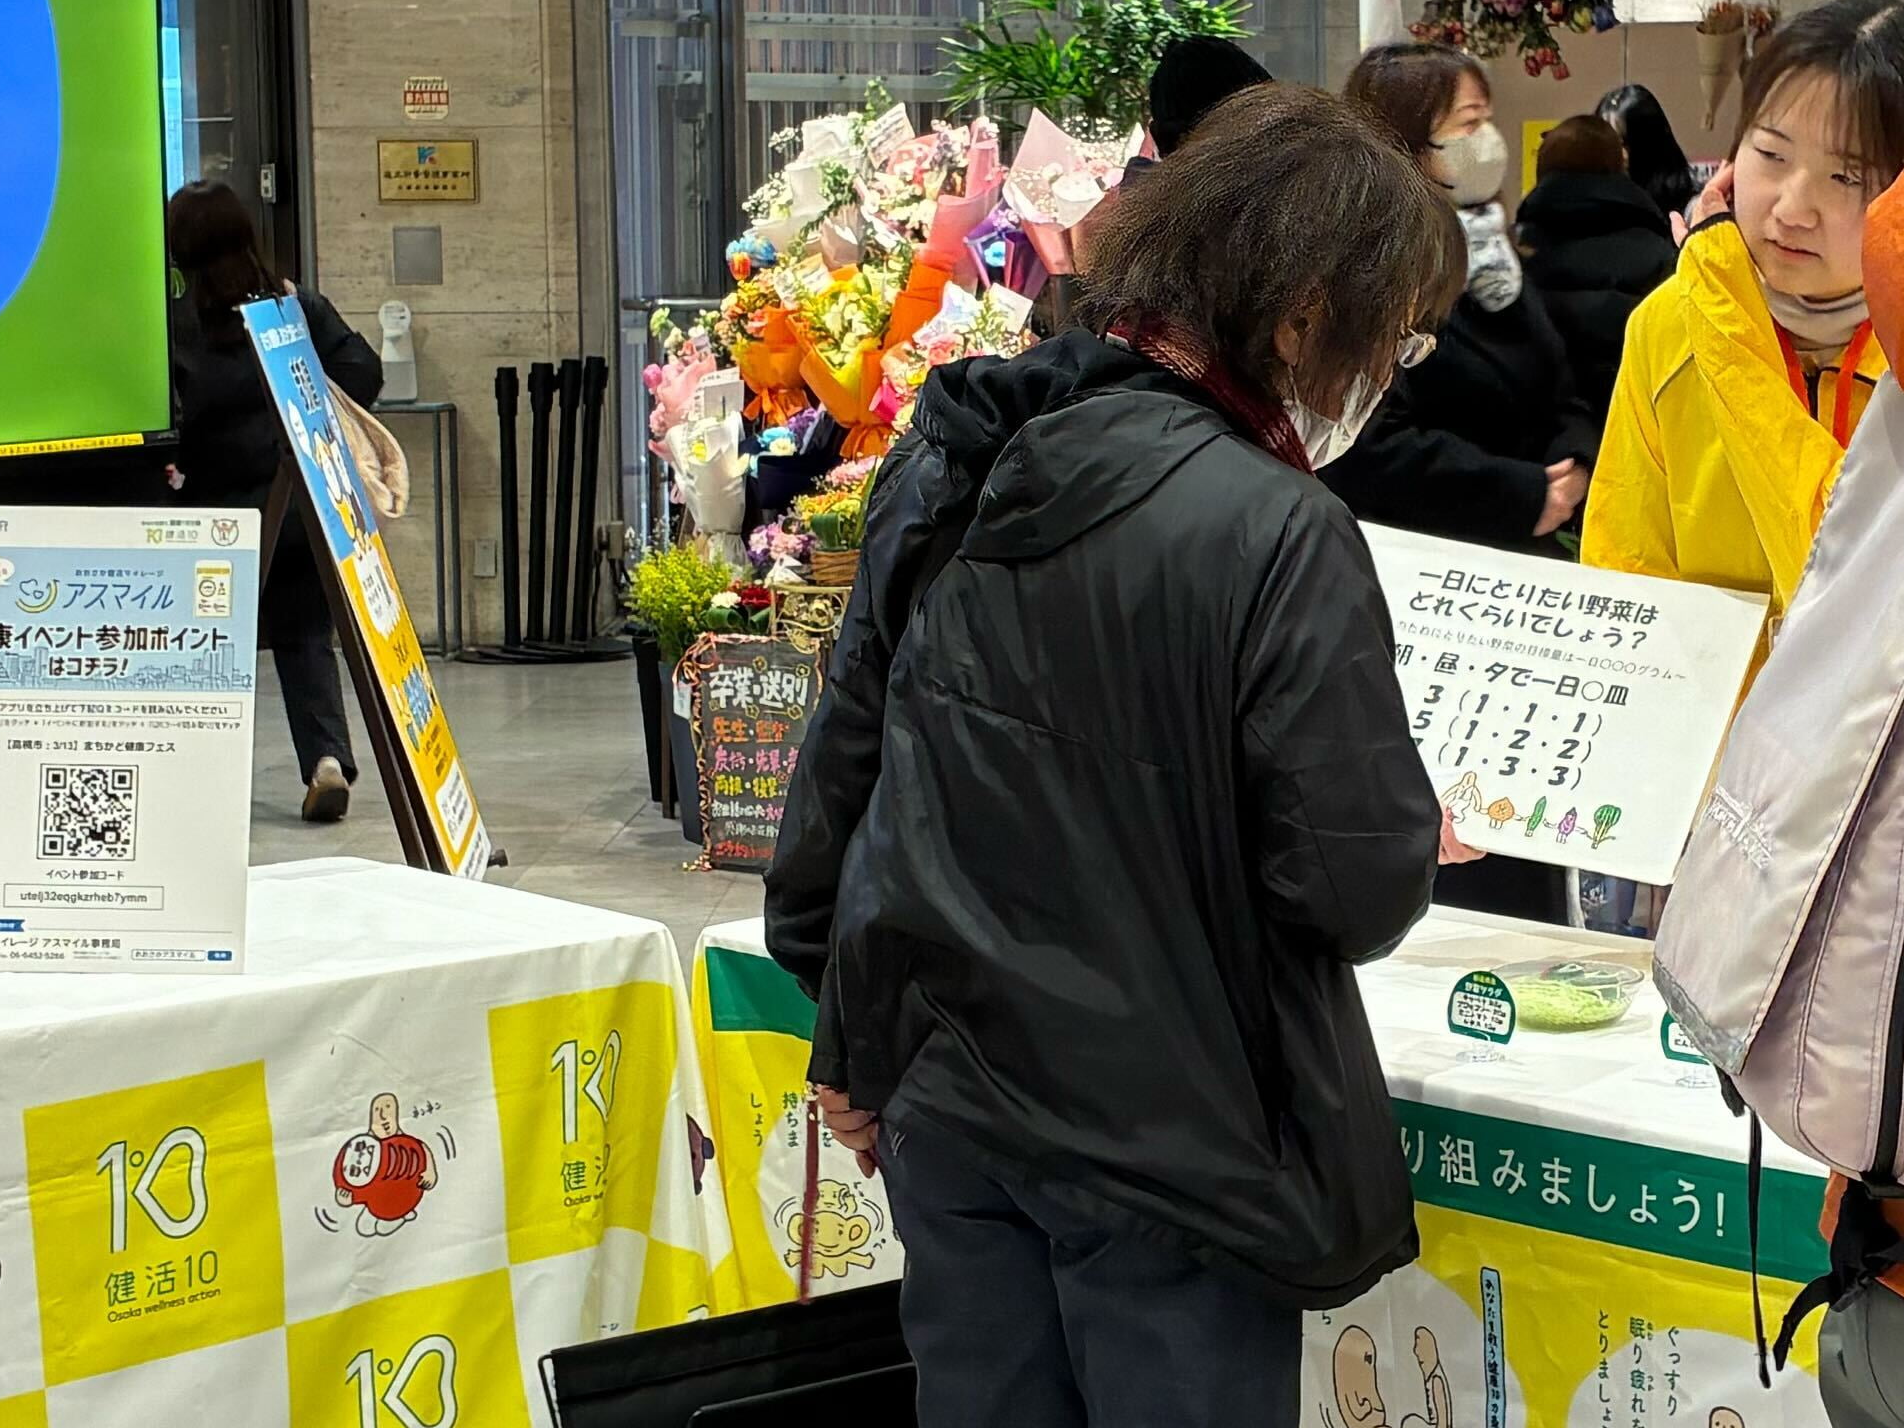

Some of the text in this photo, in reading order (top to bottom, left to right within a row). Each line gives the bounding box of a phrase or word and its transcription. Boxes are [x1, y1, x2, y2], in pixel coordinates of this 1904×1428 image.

[62, 582, 175, 610] アスマイル
[1418, 568, 1660, 626] 一日にとりたい野菜は
[48, 657, 129, 678] はコチラ!
[709, 664, 809, 709] 卒業・送別
[1423, 684, 1444, 704] 3
[1412, 710, 1433, 730] 5
[45, 869, 125, 881] イベント参加コード
[749, 1091, 763, 1148] しょう
[104, 1250, 219, 1308] 健活10
[107, 1287, 222, 1323] Osaka wellness action
[1667, 1324, 1682, 1417] ぐっすり
